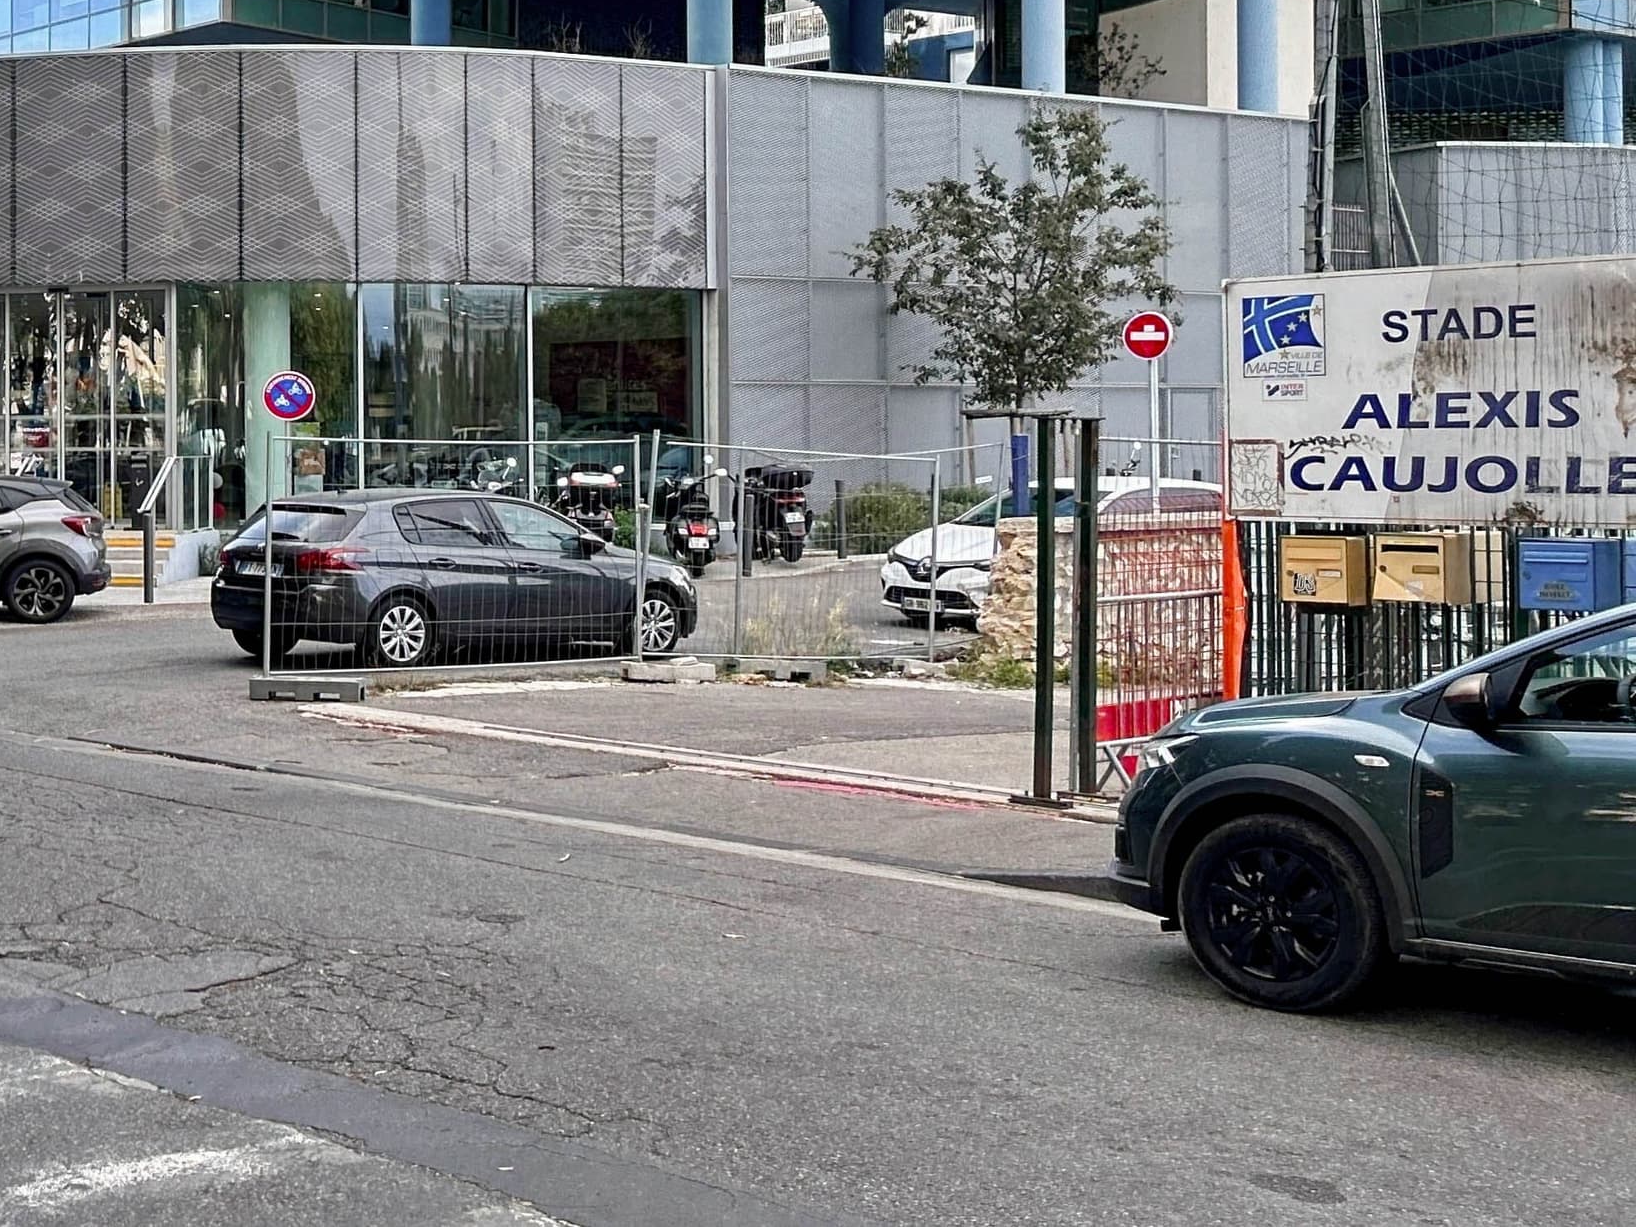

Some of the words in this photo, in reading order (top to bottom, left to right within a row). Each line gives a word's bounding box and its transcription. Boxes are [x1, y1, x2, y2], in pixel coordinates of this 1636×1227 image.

[1381, 304, 1537, 343] STADE
[1246, 360, 1323, 374] MARSEILLE
[1341, 389, 1581, 430] ALEXIS
[1290, 455, 1636, 494] CAUJOLLE
